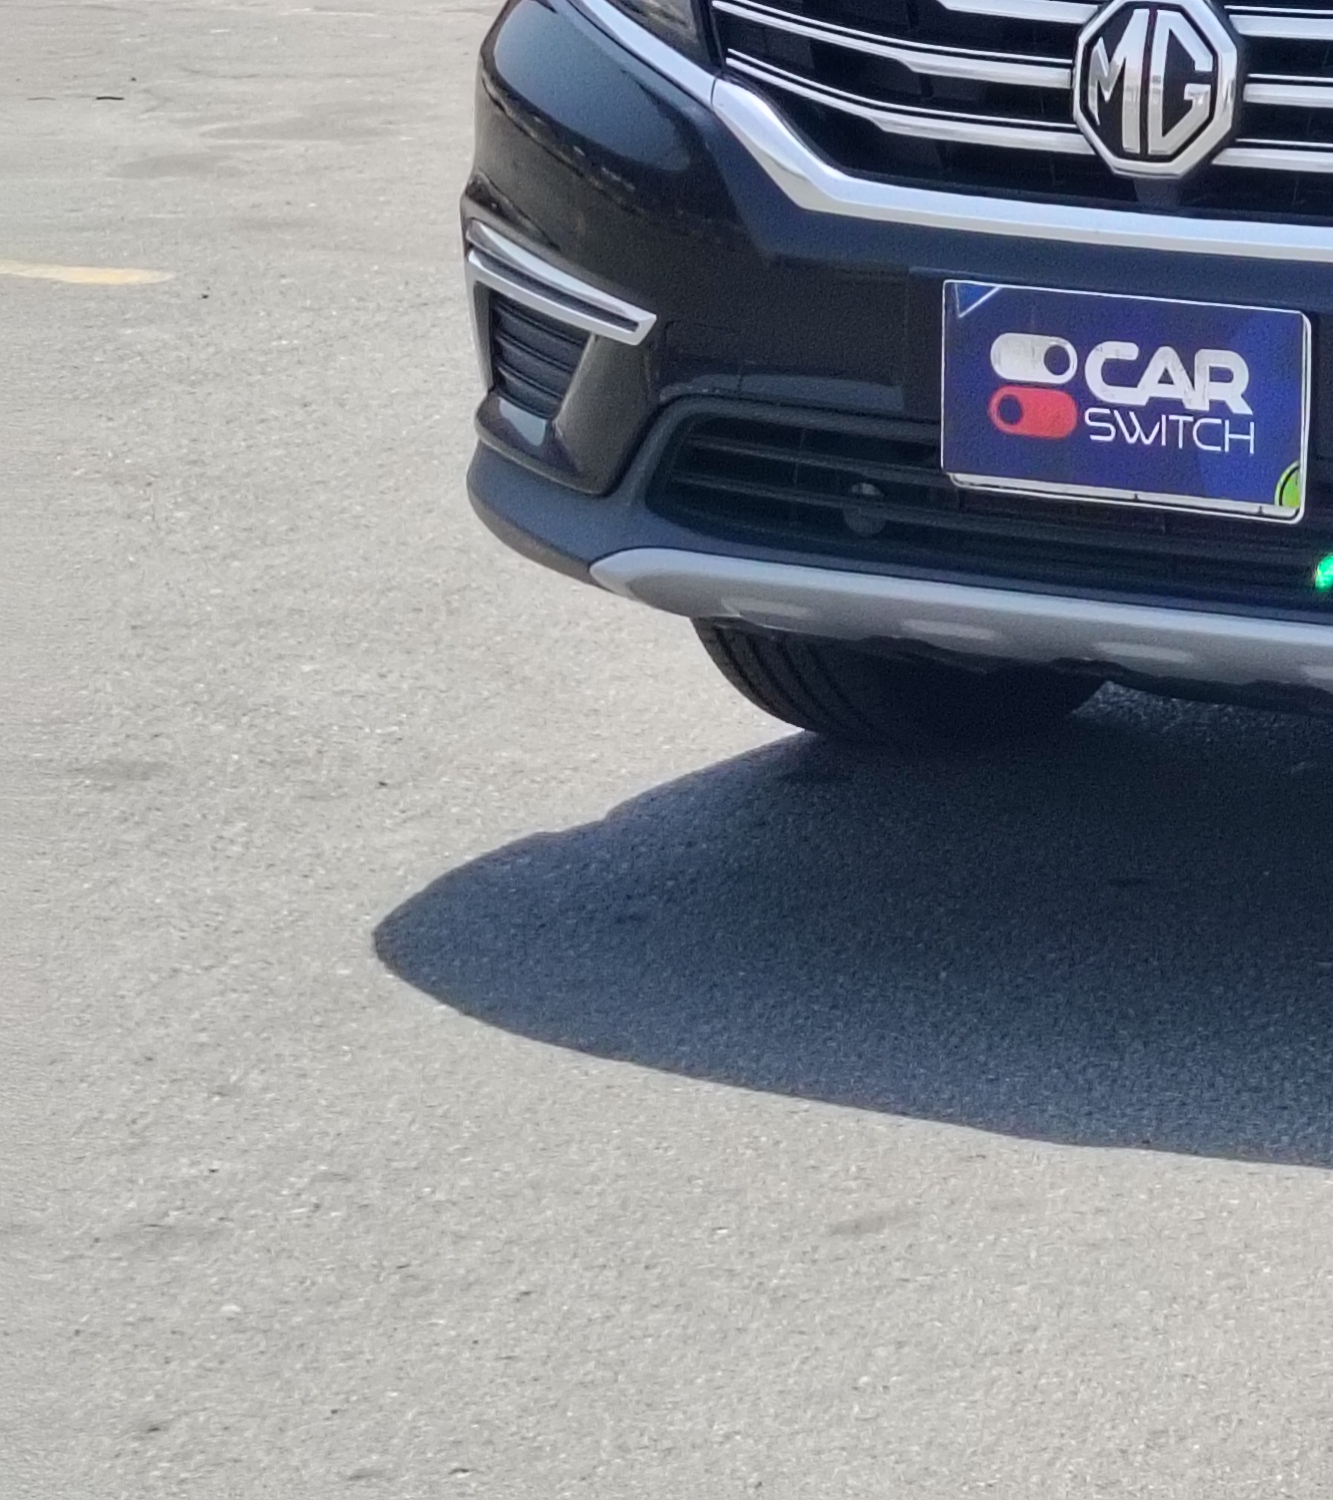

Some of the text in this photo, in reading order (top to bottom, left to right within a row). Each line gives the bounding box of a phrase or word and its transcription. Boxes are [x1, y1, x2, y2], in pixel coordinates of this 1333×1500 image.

[1088, 8, 1214, 156] MG
[1084, 340, 1254, 416] CAR
[1084, 406, 1255, 455] SWITCH
